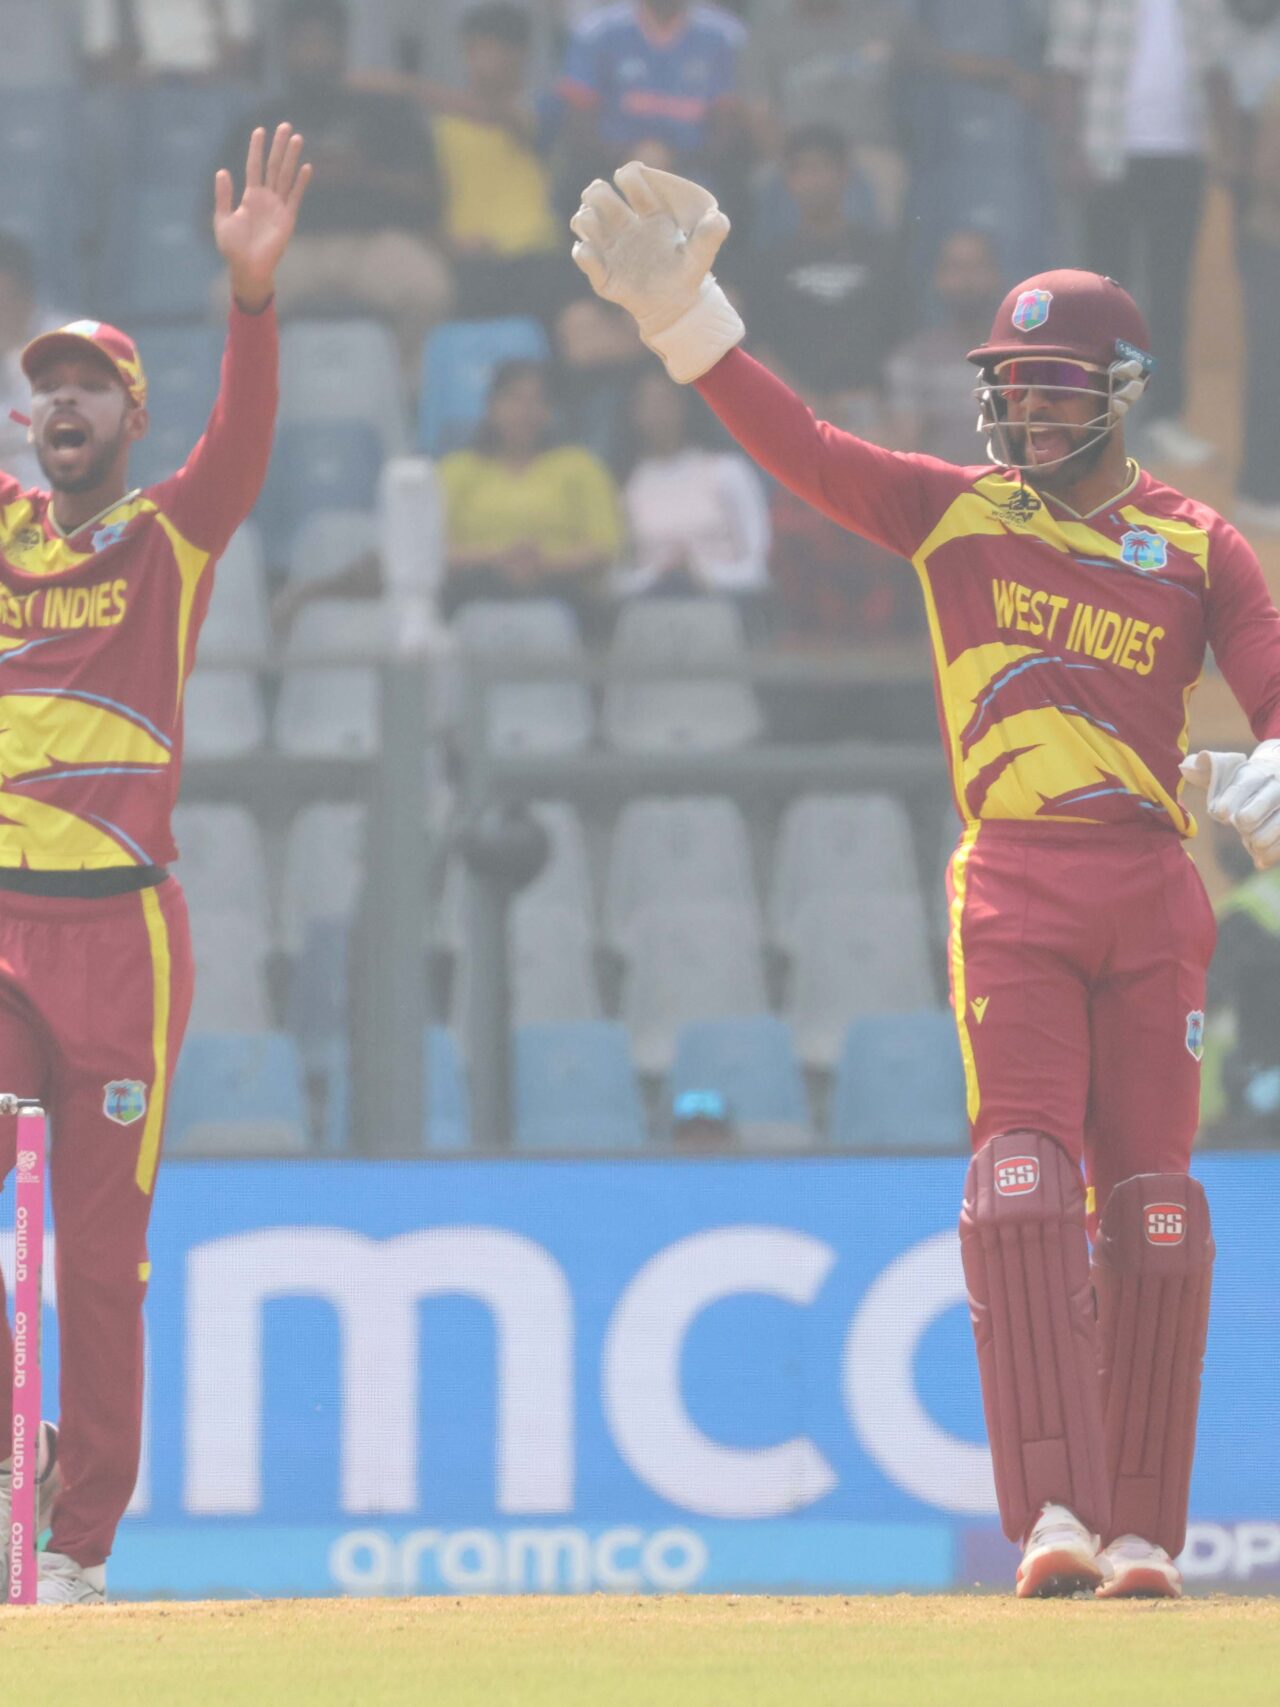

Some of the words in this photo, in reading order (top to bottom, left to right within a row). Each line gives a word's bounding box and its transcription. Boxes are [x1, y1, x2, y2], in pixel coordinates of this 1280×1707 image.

[42, 578, 128, 629] INDIES
[991, 578, 1069, 641] WEST
[1066, 602, 1165, 676] INDIES
[998, 1164, 1034, 1188] SS
[16, 1206, 28, 1282] aramco
[1147, 1213, 1183, 1235] SS
[14, 1311, 26, 1388] aramco
[12, 1414, 25, 1490] aramco
[10, 1521, 23, 1598] aramco
[328, 1528, 708, 1592] aramco
